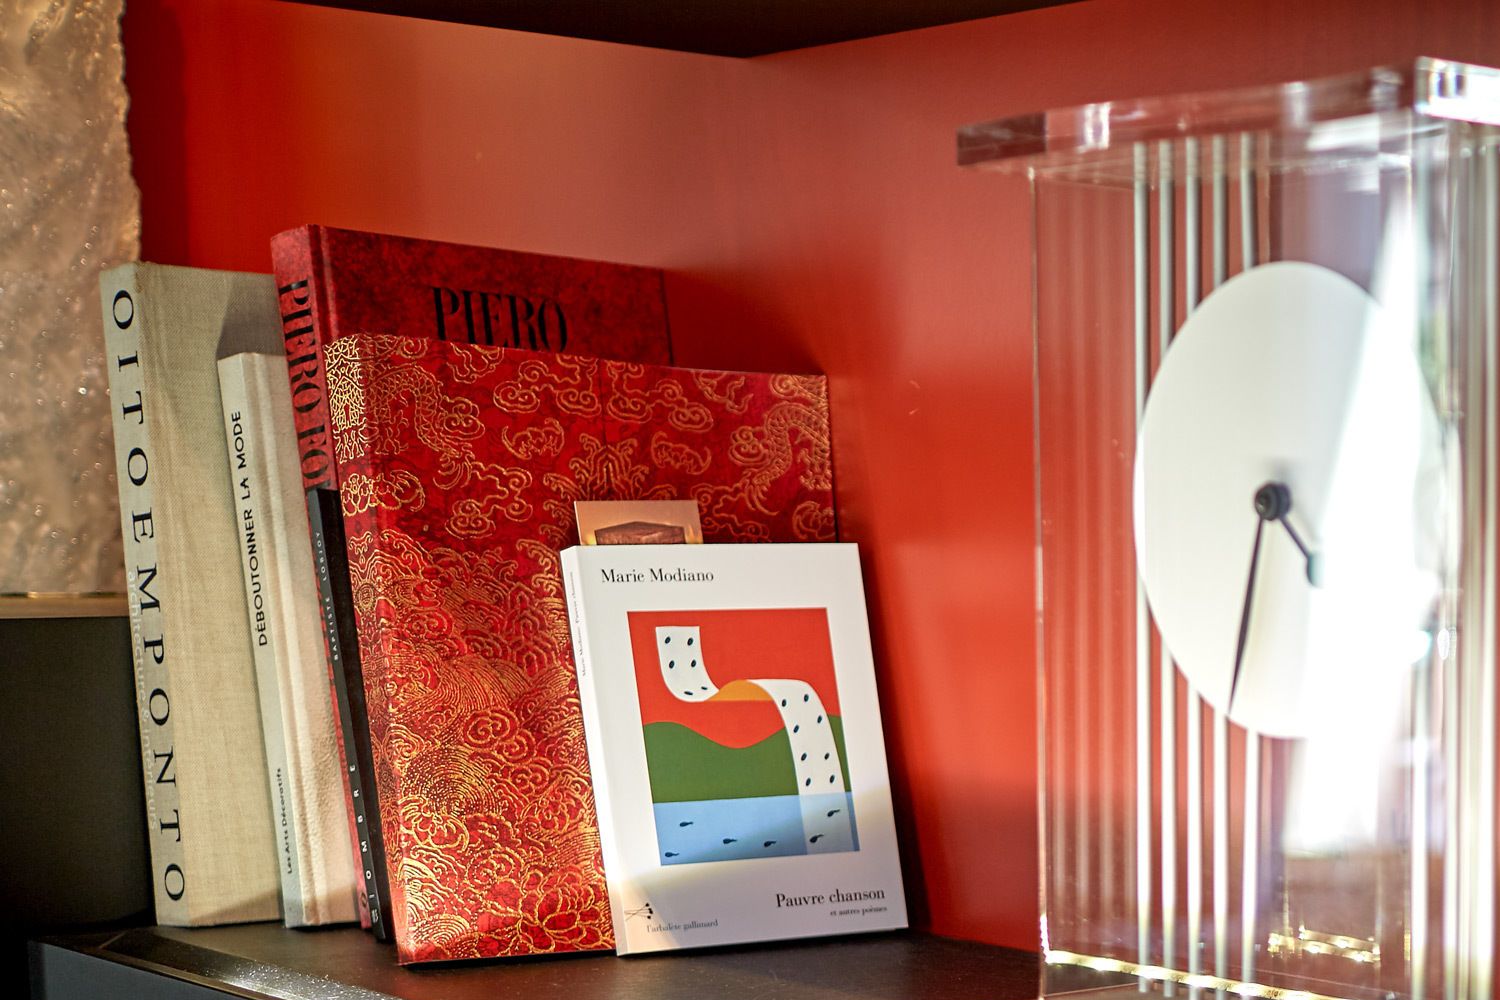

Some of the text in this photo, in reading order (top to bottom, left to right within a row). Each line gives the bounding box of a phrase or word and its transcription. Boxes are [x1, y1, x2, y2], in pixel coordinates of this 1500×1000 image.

[279, 279, 322, 414] PIERO
[432, 287, 568, 353] PIERO
[231, 410, 268, 646] DÉBOUTONNER LA MODE
[601, 567, 714, 584] Marie Modiano
[324, 596, 339, 661] BAPTISTE
[128, 571, 149, 702] architecture
[142, 729, 158, 831] intérieurs
[275, 767, 294, 875] Les Arts Décoratifs
[776, 886, 886, 909] Pauvre chanson
[840, 907, 860, 917] autres
[861, 904, 888, 917] poèmes
